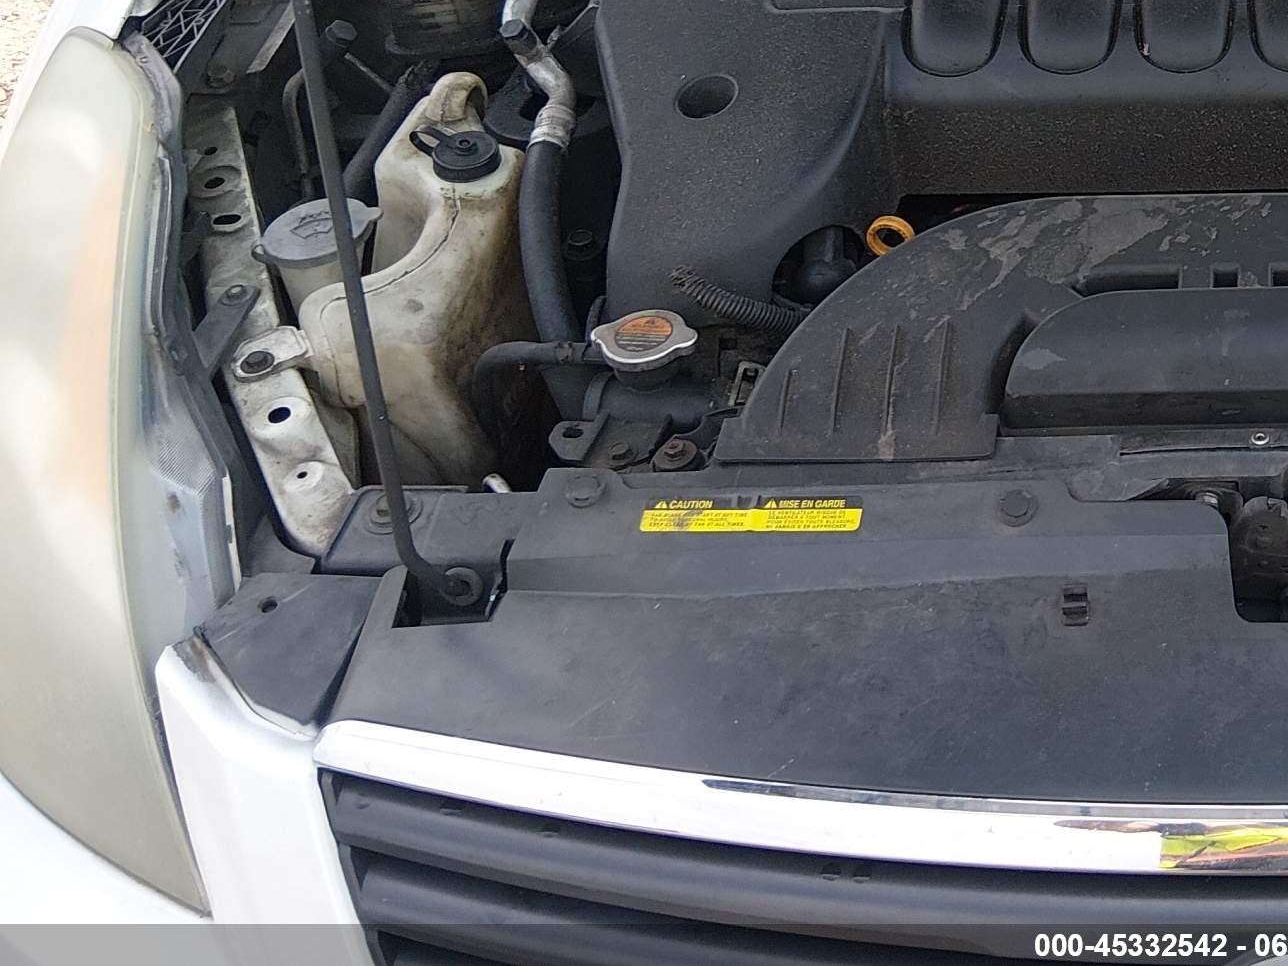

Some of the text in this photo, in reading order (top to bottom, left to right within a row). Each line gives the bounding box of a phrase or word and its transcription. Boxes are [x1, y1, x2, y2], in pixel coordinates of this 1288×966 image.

[669, 500, 714, 510] CAUTION
[779, 499, 846, 509] MISE EN GARDE
